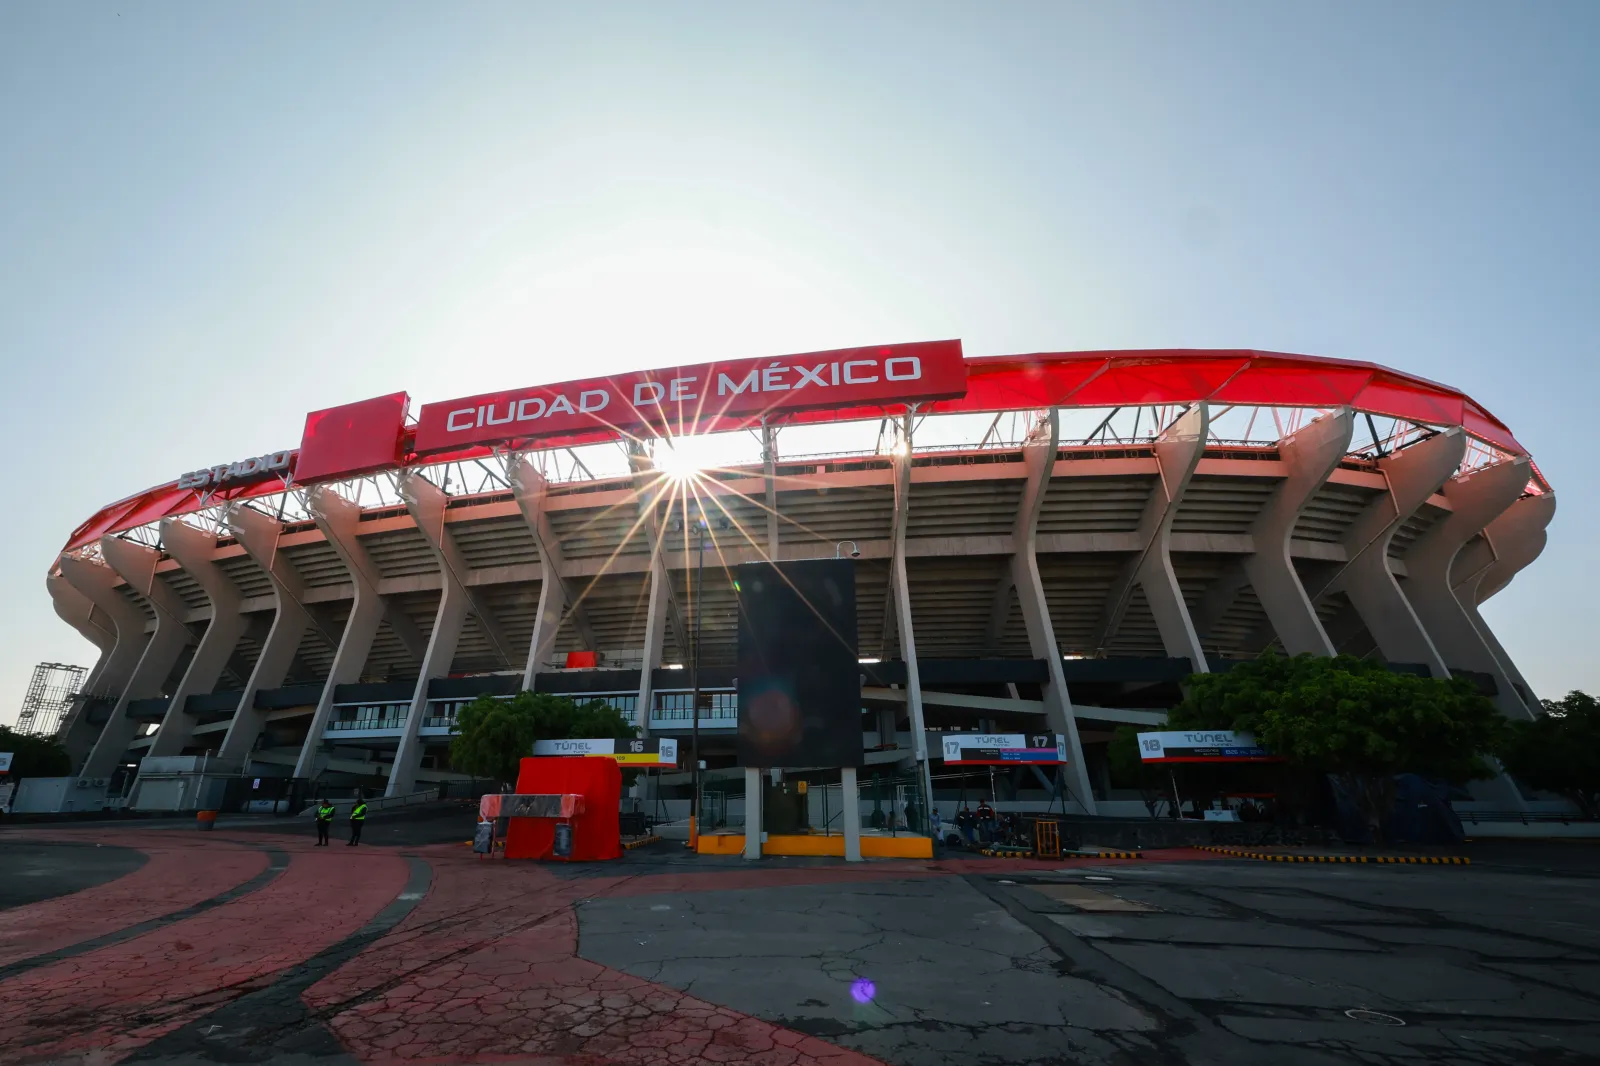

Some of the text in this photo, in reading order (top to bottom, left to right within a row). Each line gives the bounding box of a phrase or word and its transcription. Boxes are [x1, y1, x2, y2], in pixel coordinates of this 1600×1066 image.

[447, 356, 922, 432] CIUDAD DE MÉXICO
[178, 450, 290, 489] ESTADIO
[975, 736, 1010, 744] TÚNEL
[1032, 735, 1048, 748] 17
[1184, 733, 1233, 742] TÚNEL
[555, 741, 591, 750] TÚNEL
[629, 740, 644, 752] 16
[661, 745, 674, 757] 16
[944, 742, 960, 755] 17
[1142, 739, 1161, 752] 18
